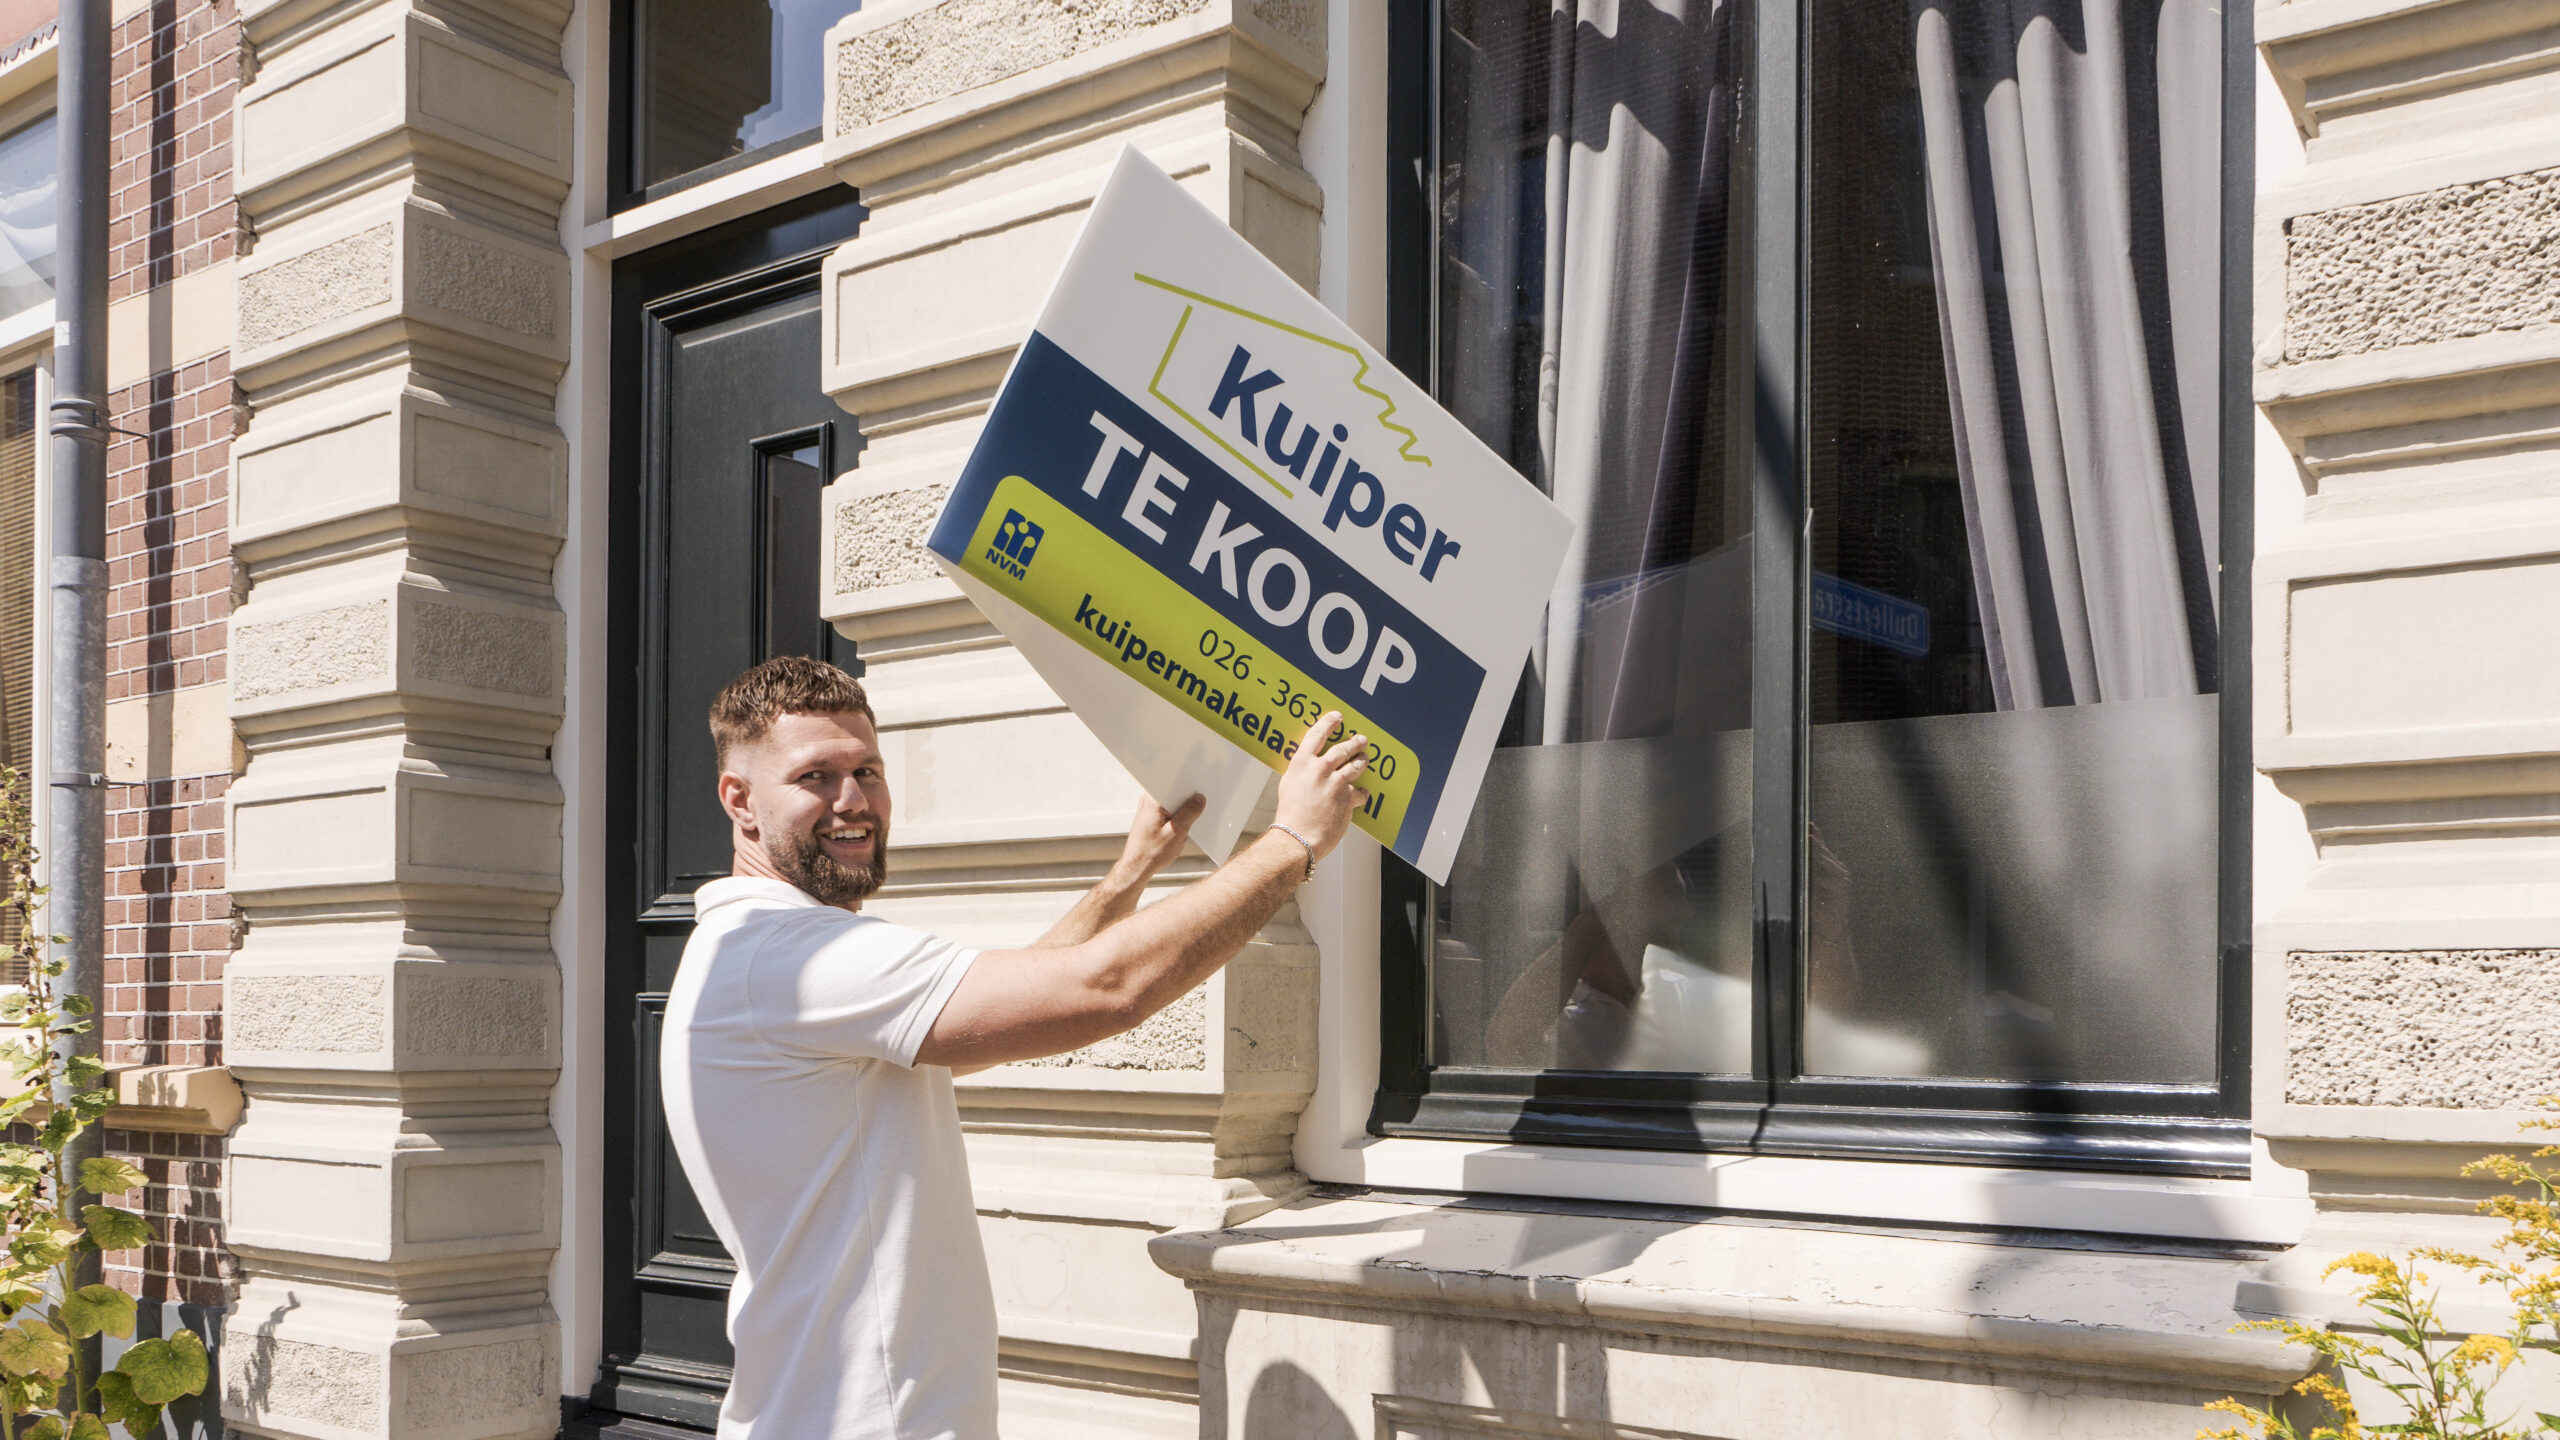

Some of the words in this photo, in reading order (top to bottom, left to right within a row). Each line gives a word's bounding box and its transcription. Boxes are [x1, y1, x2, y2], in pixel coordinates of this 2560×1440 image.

[1208, 344, 1461, 583] Kuiper
[984, 547, 1027, 582] NVM
[1081, 410, 1190, 546] TE
[1189, 499, 1418, 696] KOOP
[1199, 629, 1252, 681] 026
[1271, 678, 1322, 728] 363
